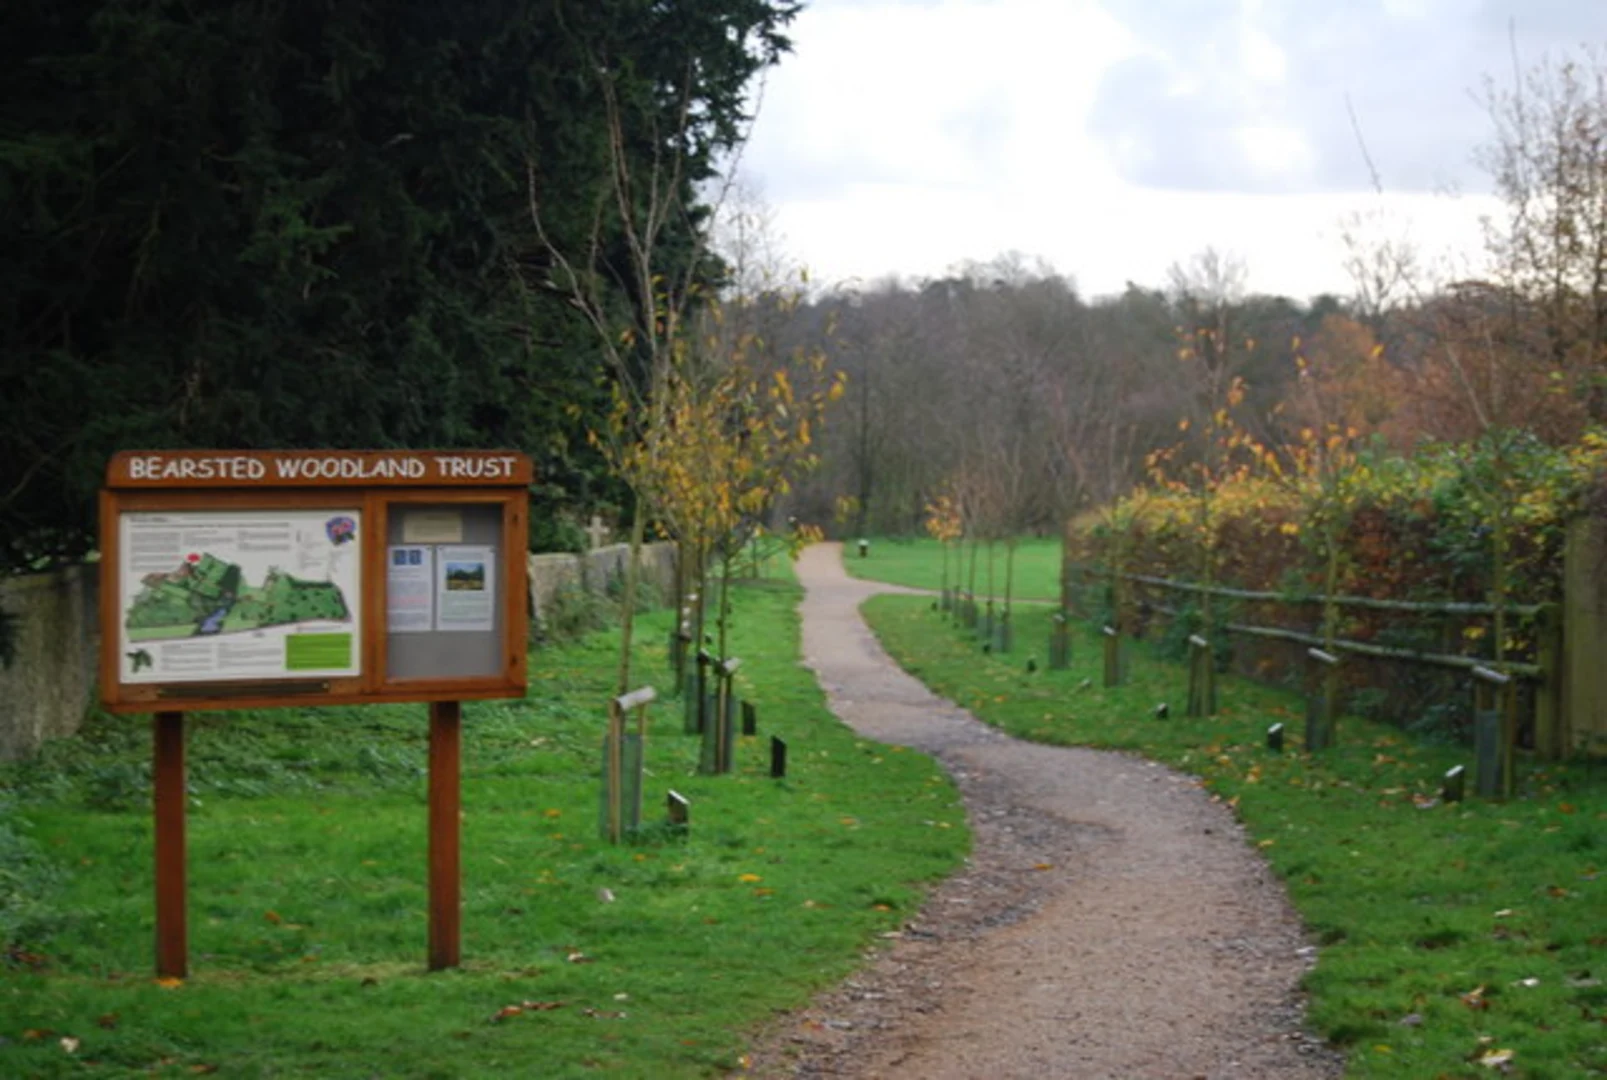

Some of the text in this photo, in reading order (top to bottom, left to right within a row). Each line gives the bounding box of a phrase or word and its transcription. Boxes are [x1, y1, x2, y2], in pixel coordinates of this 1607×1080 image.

[129, 456, 515, 480] BEARSTED WOODLAND TRUST
